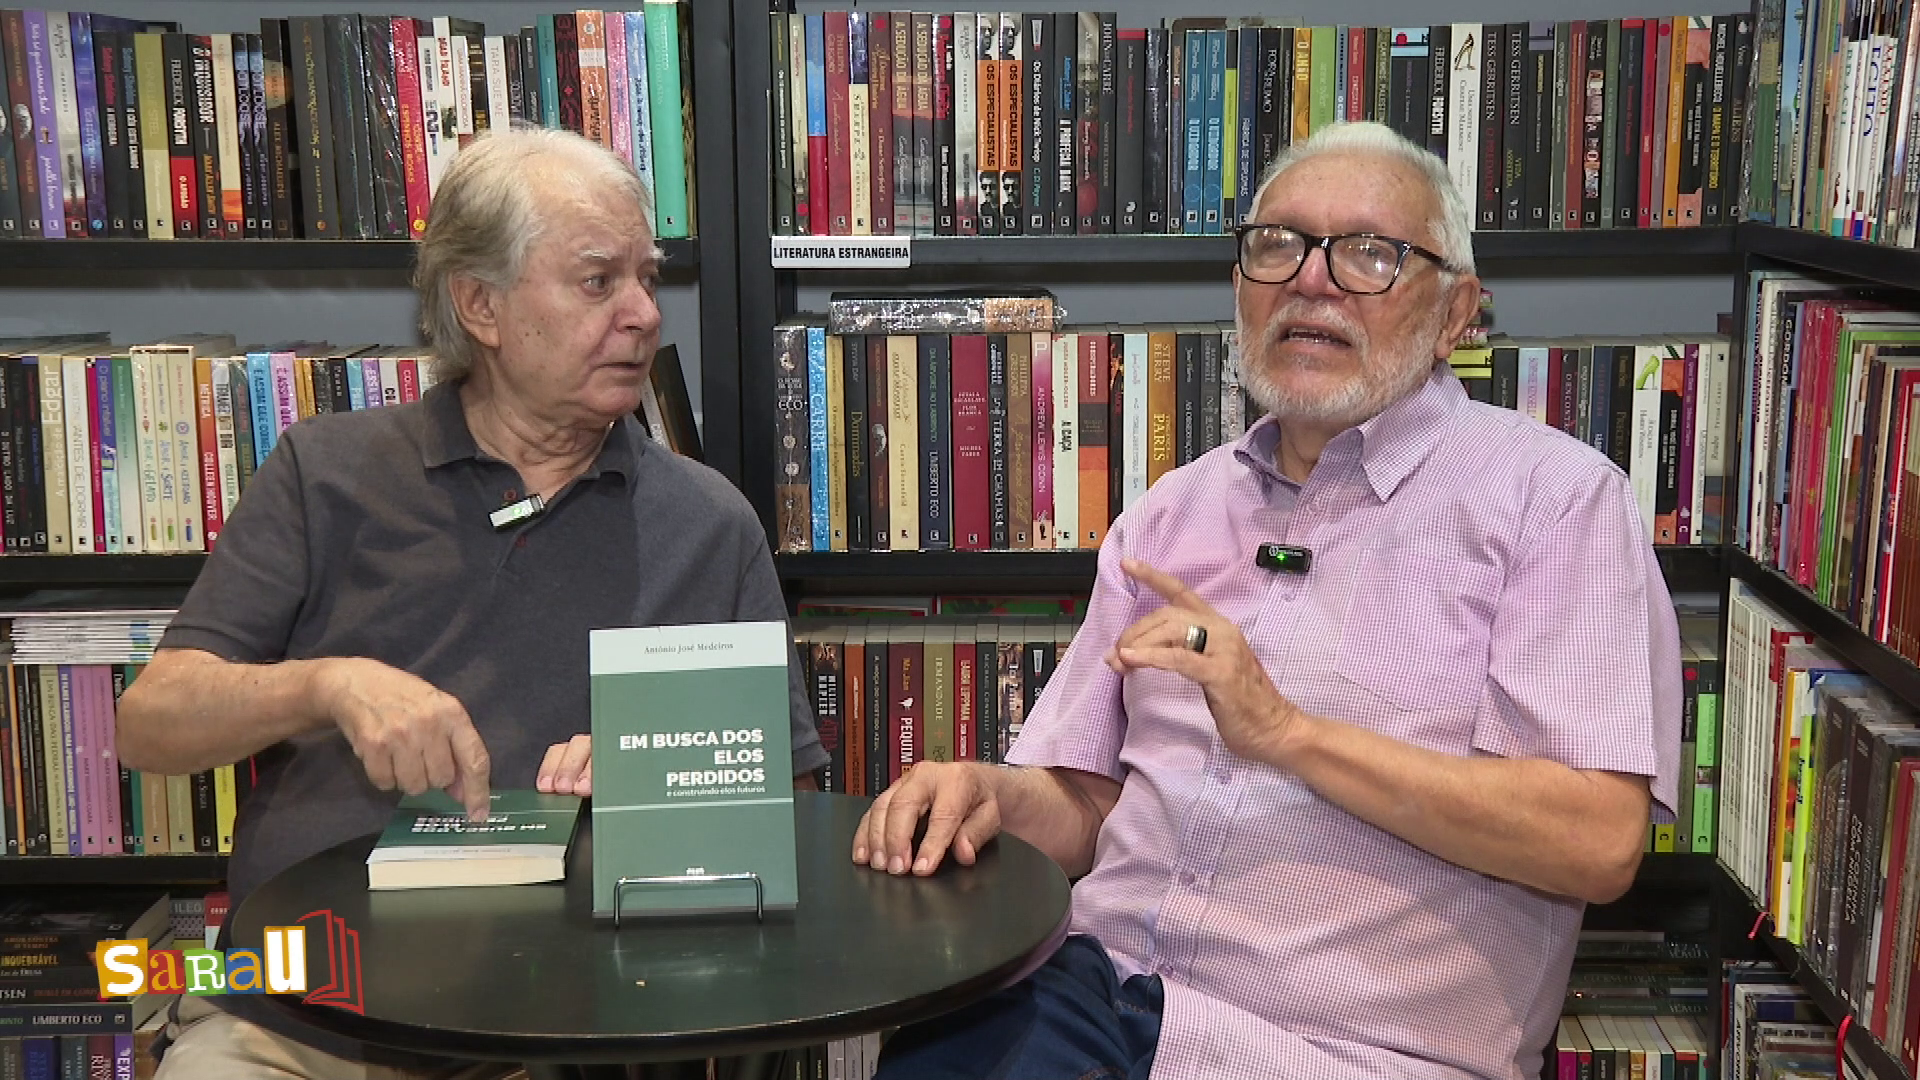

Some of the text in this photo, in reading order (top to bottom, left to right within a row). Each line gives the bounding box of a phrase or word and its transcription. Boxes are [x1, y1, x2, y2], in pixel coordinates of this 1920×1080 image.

[1102, 21, 1113, 51] JOHN
[1716, 23, 1727, 51] MICHEL
[490, 46, 504, 117] TARA SUE ME
[1032, 60, 1041, 73] Os
[1485, 31, 1495, 120] TESS GERRITSEN
[1510, 30, 1521, 125] TESS GERRITSEN
[171, 59, 188, 145] FREDERICK FORSYTH
[1032, 73, 1043, 104] Diários
[1431, 47, 1445, 135] FREDERICK FORSYTH
[986, 64, 996, 167] OS ESPECIALISTAS
[1009, 64, 1018, 167] OS ESPECIALISTAS
[1032, 117, 1041, 137] Nick
[774, 247, 910, 259] LITERATURA ESTRANGEIRA
[1010, 353, 1019, 397] GREGORY
[1153, 343, 1163, 383] BERRY
[1163, 344, 1171, 383] STEVE
[41, 365, 63, 425] Edgar
[1037, 385, 1046, 429] ANDREW
[850, 411, 864, 477] Dominadas
[993, 419, 1003, 456] TERRA
[1038, 431, 1047, 462] LEWIS
[1153, 413, 1166, 462] PARIS
[75, 465, 87, 483] DE
[203, 451, 215, 487] COLLEEN
[929, 451, 940, 518] UMBERTO ECO
[76, 485, 87, 529] DORMIR
[677, 643, 695, 654] José
[697, 641, 735, 651] Medeiros
[934, 657, 943, 721] IRMANDADE
[619, 728, 764, 750] EM BUSCA DOS
[714, 748, 765, 765] ELOS
[898, 717, 913, 763] PEQUIM
[667, 767, 766, 787] PERDIDOS
[673, 787, 720, 797] construindo
[720, 786, 736, 796] elos
[737, 785, 766, 795] futuros
[33, 1013, 102, 1026] UMBERTO ECO
